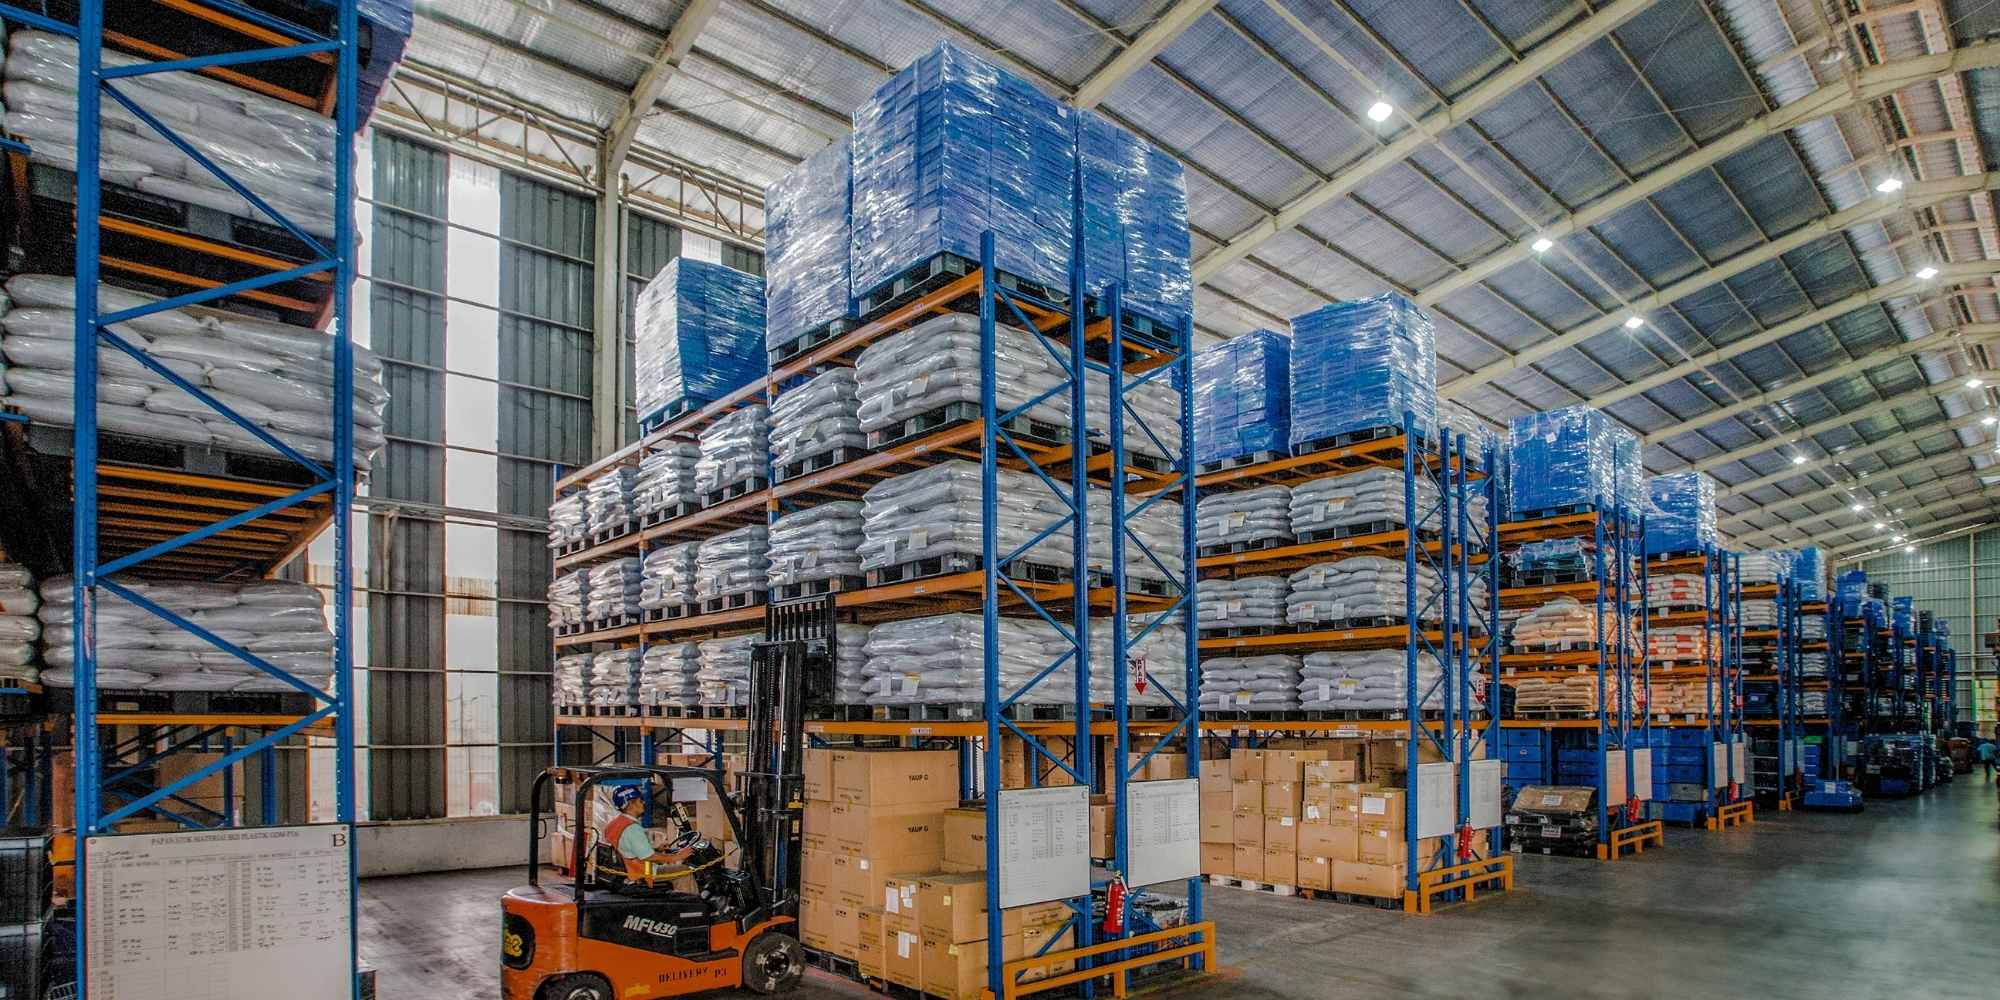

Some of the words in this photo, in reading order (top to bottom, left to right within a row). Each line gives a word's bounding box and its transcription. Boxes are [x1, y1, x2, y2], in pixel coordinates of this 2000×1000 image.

[332, 833, 346, 848] B
[623, 915, 679, 938] MFL430
[657, 967, 709, 983] DELIVERY
